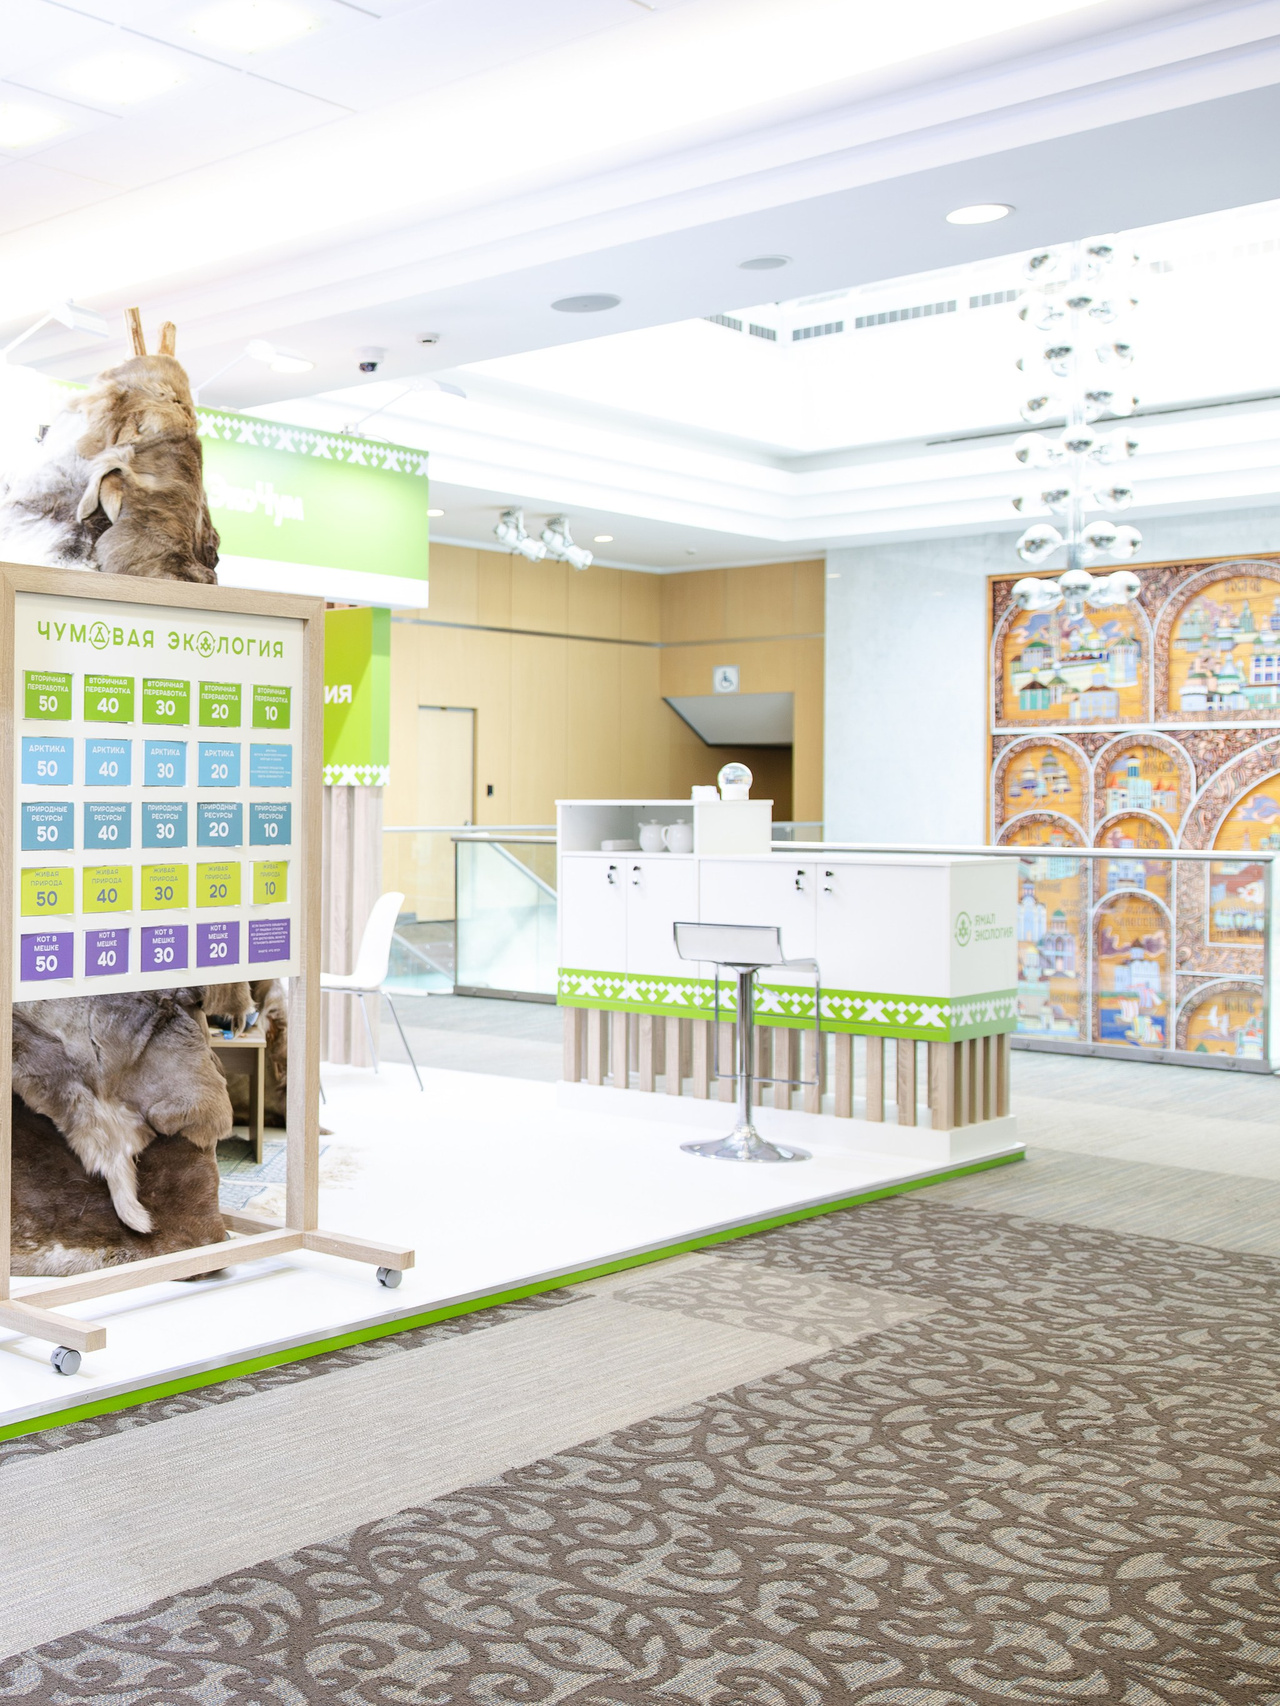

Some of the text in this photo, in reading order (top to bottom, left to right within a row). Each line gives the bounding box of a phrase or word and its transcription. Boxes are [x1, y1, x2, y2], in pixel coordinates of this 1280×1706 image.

[31, 674, 66, 683] ВТОРИЧНАЯ
[89, 677, 127, 685] ВТОРИЧНАЯ
[147, 681, 184, 689] ВТОРИЧНАЯ
[27, 683, 69, 692] ПЕРЕРАБОТКА
[85, 686, 131, 694] ПЕРЕРАБОТКА
[144, 689, 187, 697] ПЕРЕРАБОТКА
[257, 687, 286, 695] ВТОРИЧНАЯ
[39, 695, 58, 712] 50
[201, 693, 238, 701] ПЕРЕРАБОТКА
[254, 695, 288, 703] ПЕРЕРАБОТКА
[97, 698, 119, 713] 40
[156, 700, 175, 716] 30
[212, 704, 229, 719] 20
[265, 706, 278, 721] 10
[92, 746, 125, 754] АРКТИКА
[151, 748, 180, 756] АРКТИКА
[37, 760, 58, 776] 50
[99, 761, 118, 777] 40
[157, 763, 174, 778] 30
[211, 764, 228, 779] 20
[26, 805, 67, 813] ПРИРОДНЫЕ
[37, 826, 58, 842] 50
[98, 825, 118, 840] 40
[156, 823, 174, 839] 30
[209, 822, 229, 837] 20
[264, 823, 278, 837] 10
[96, 888, 118, 903] 40
[154, 886, 174, 901] 30
[209, 884, 227, 898] 20
[265, 881, 276, 895] 10
[36, 891, 58, 907] 50
[34, 944, 59, 952] МЕШКЕ
[96, 940, 117, 948] МЕШКЕ
[210, 942, 227, 958] 20
[98, 950, 116, 966] 40
[154, 947, 174, 963] 30
[36, 955, 57, 972] 50
